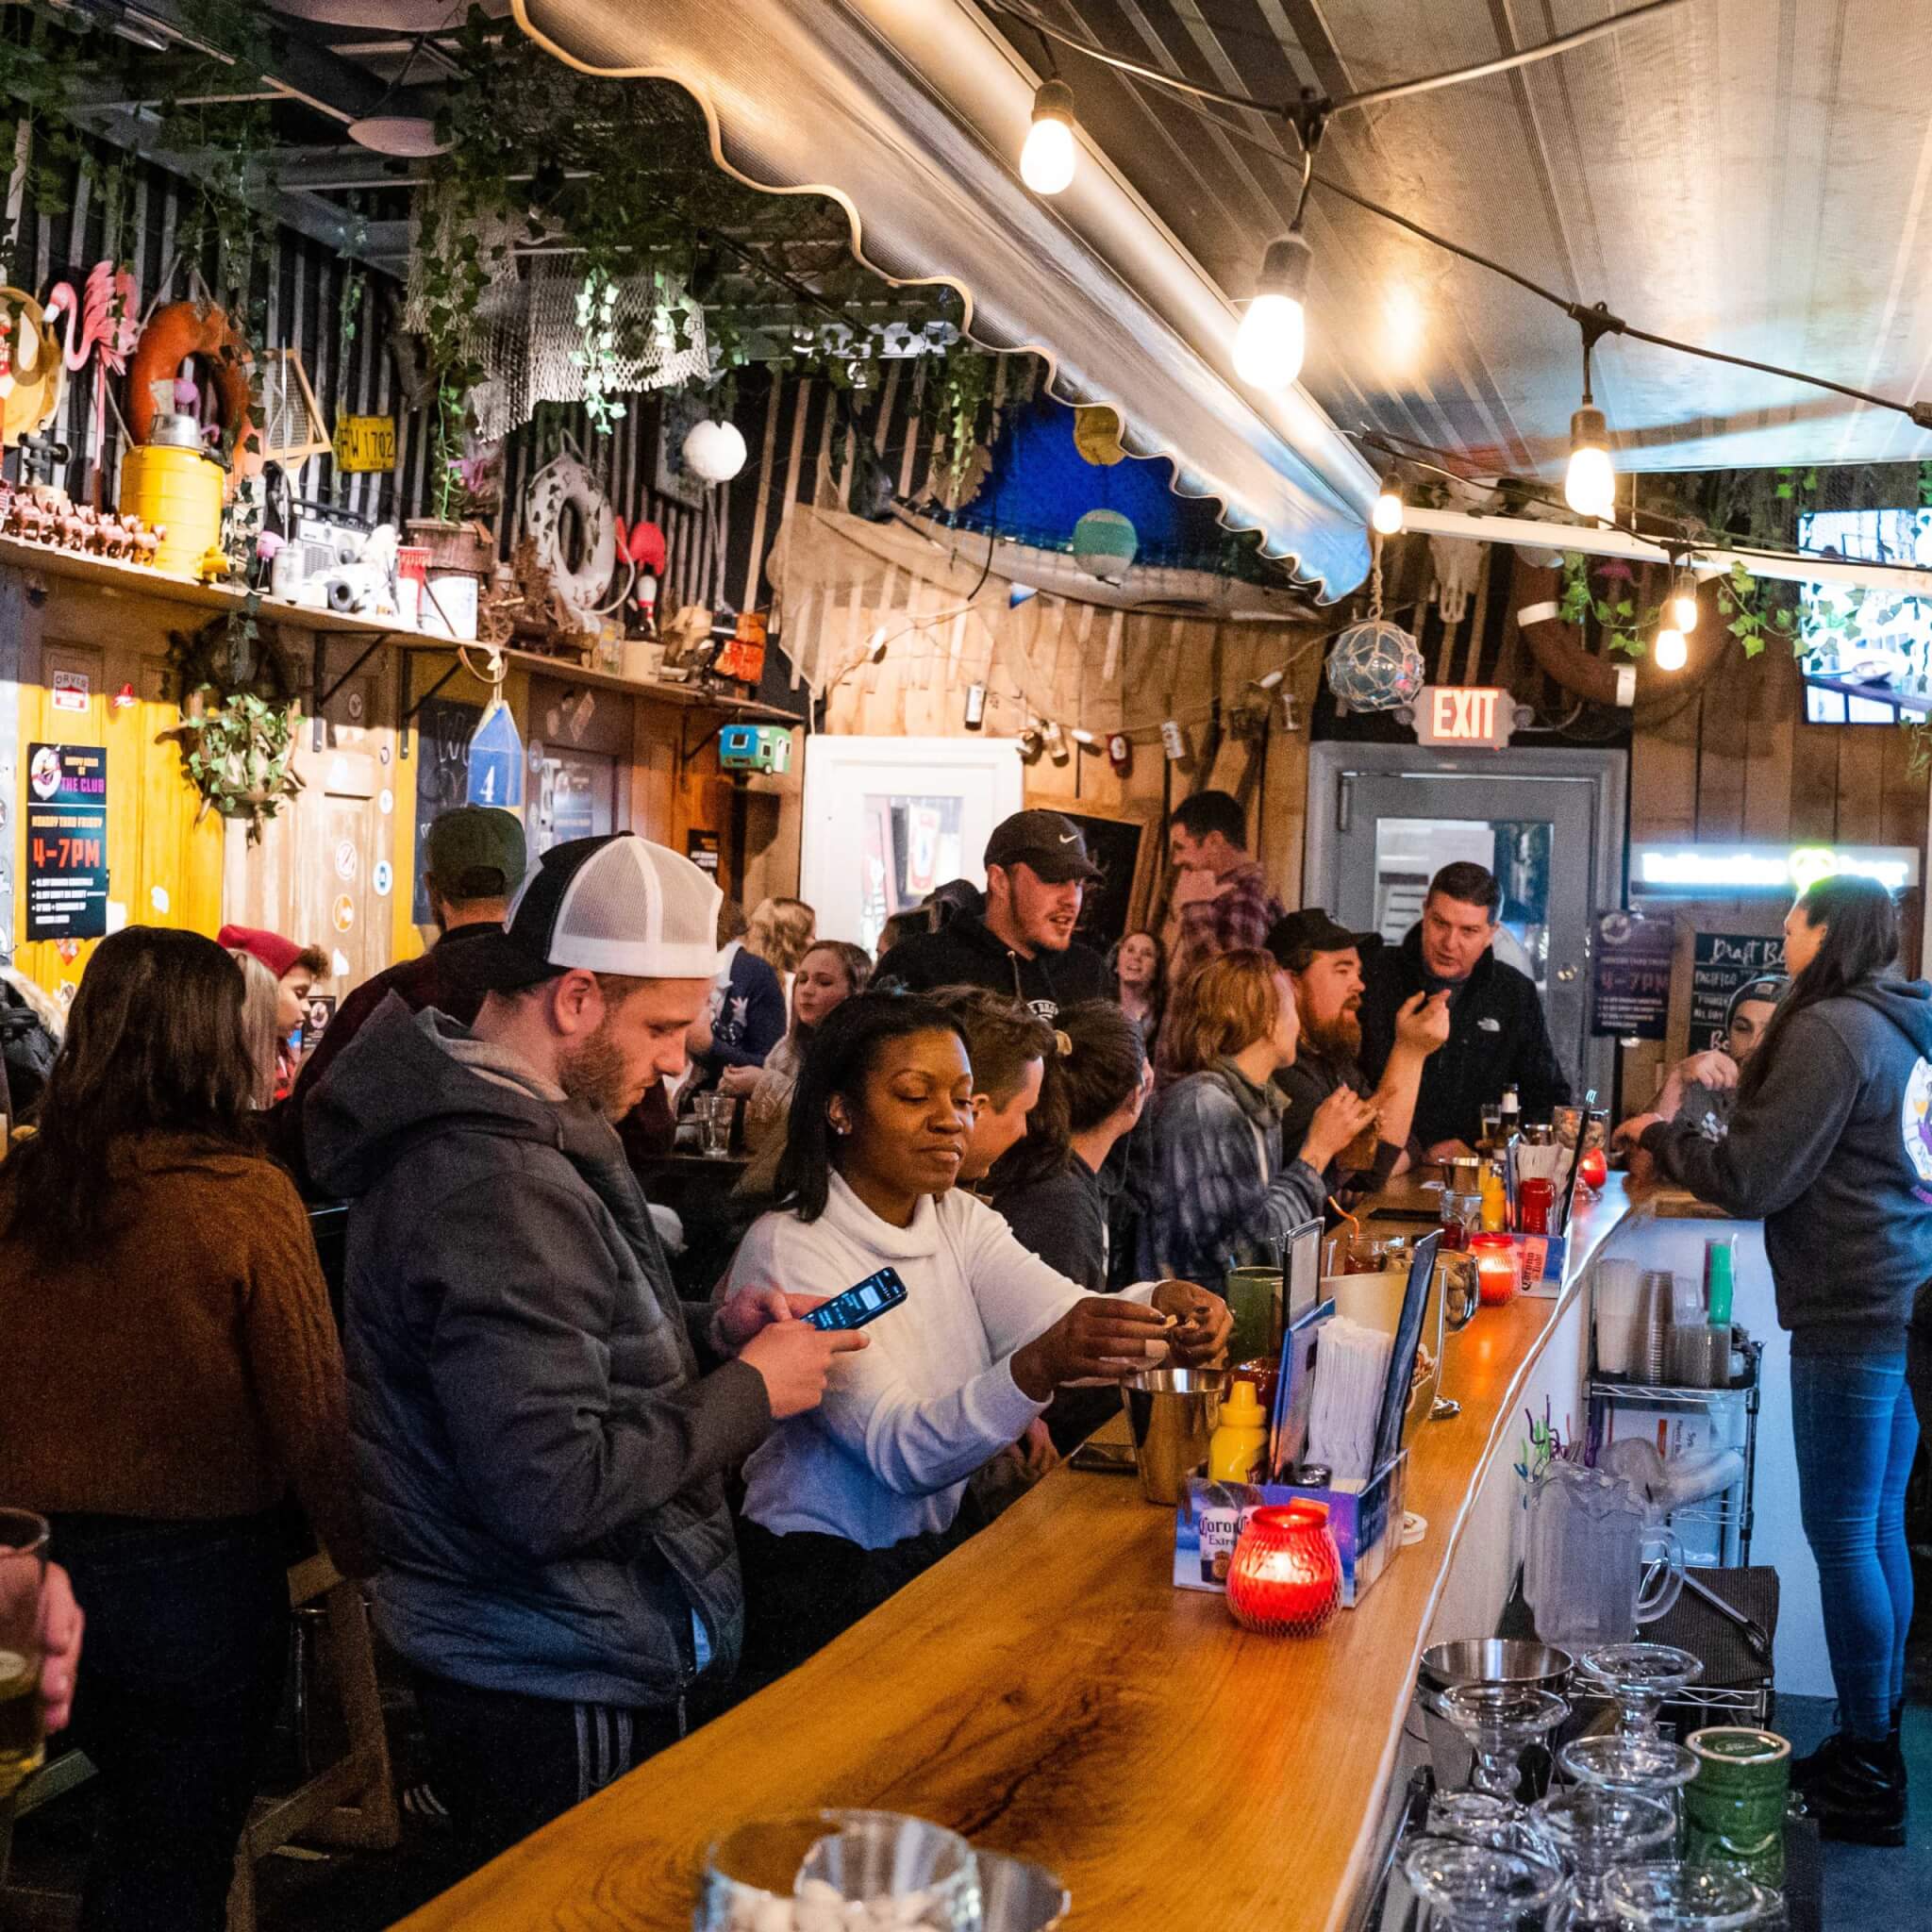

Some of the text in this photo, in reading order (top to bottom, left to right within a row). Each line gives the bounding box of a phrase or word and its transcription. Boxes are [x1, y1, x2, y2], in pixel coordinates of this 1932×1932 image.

[364, 431, 393, 458] 1702
[1433, 689, 1499, 739] EXIT
[61, 777, 106, 793] THE CLUB
[479, 765, 495, 803] 4
[32, 838, 101, 868] 4-7PM
[1708, 938, 1761, 966] Draft
[1521, 1252, 1535, 1291] Corona
